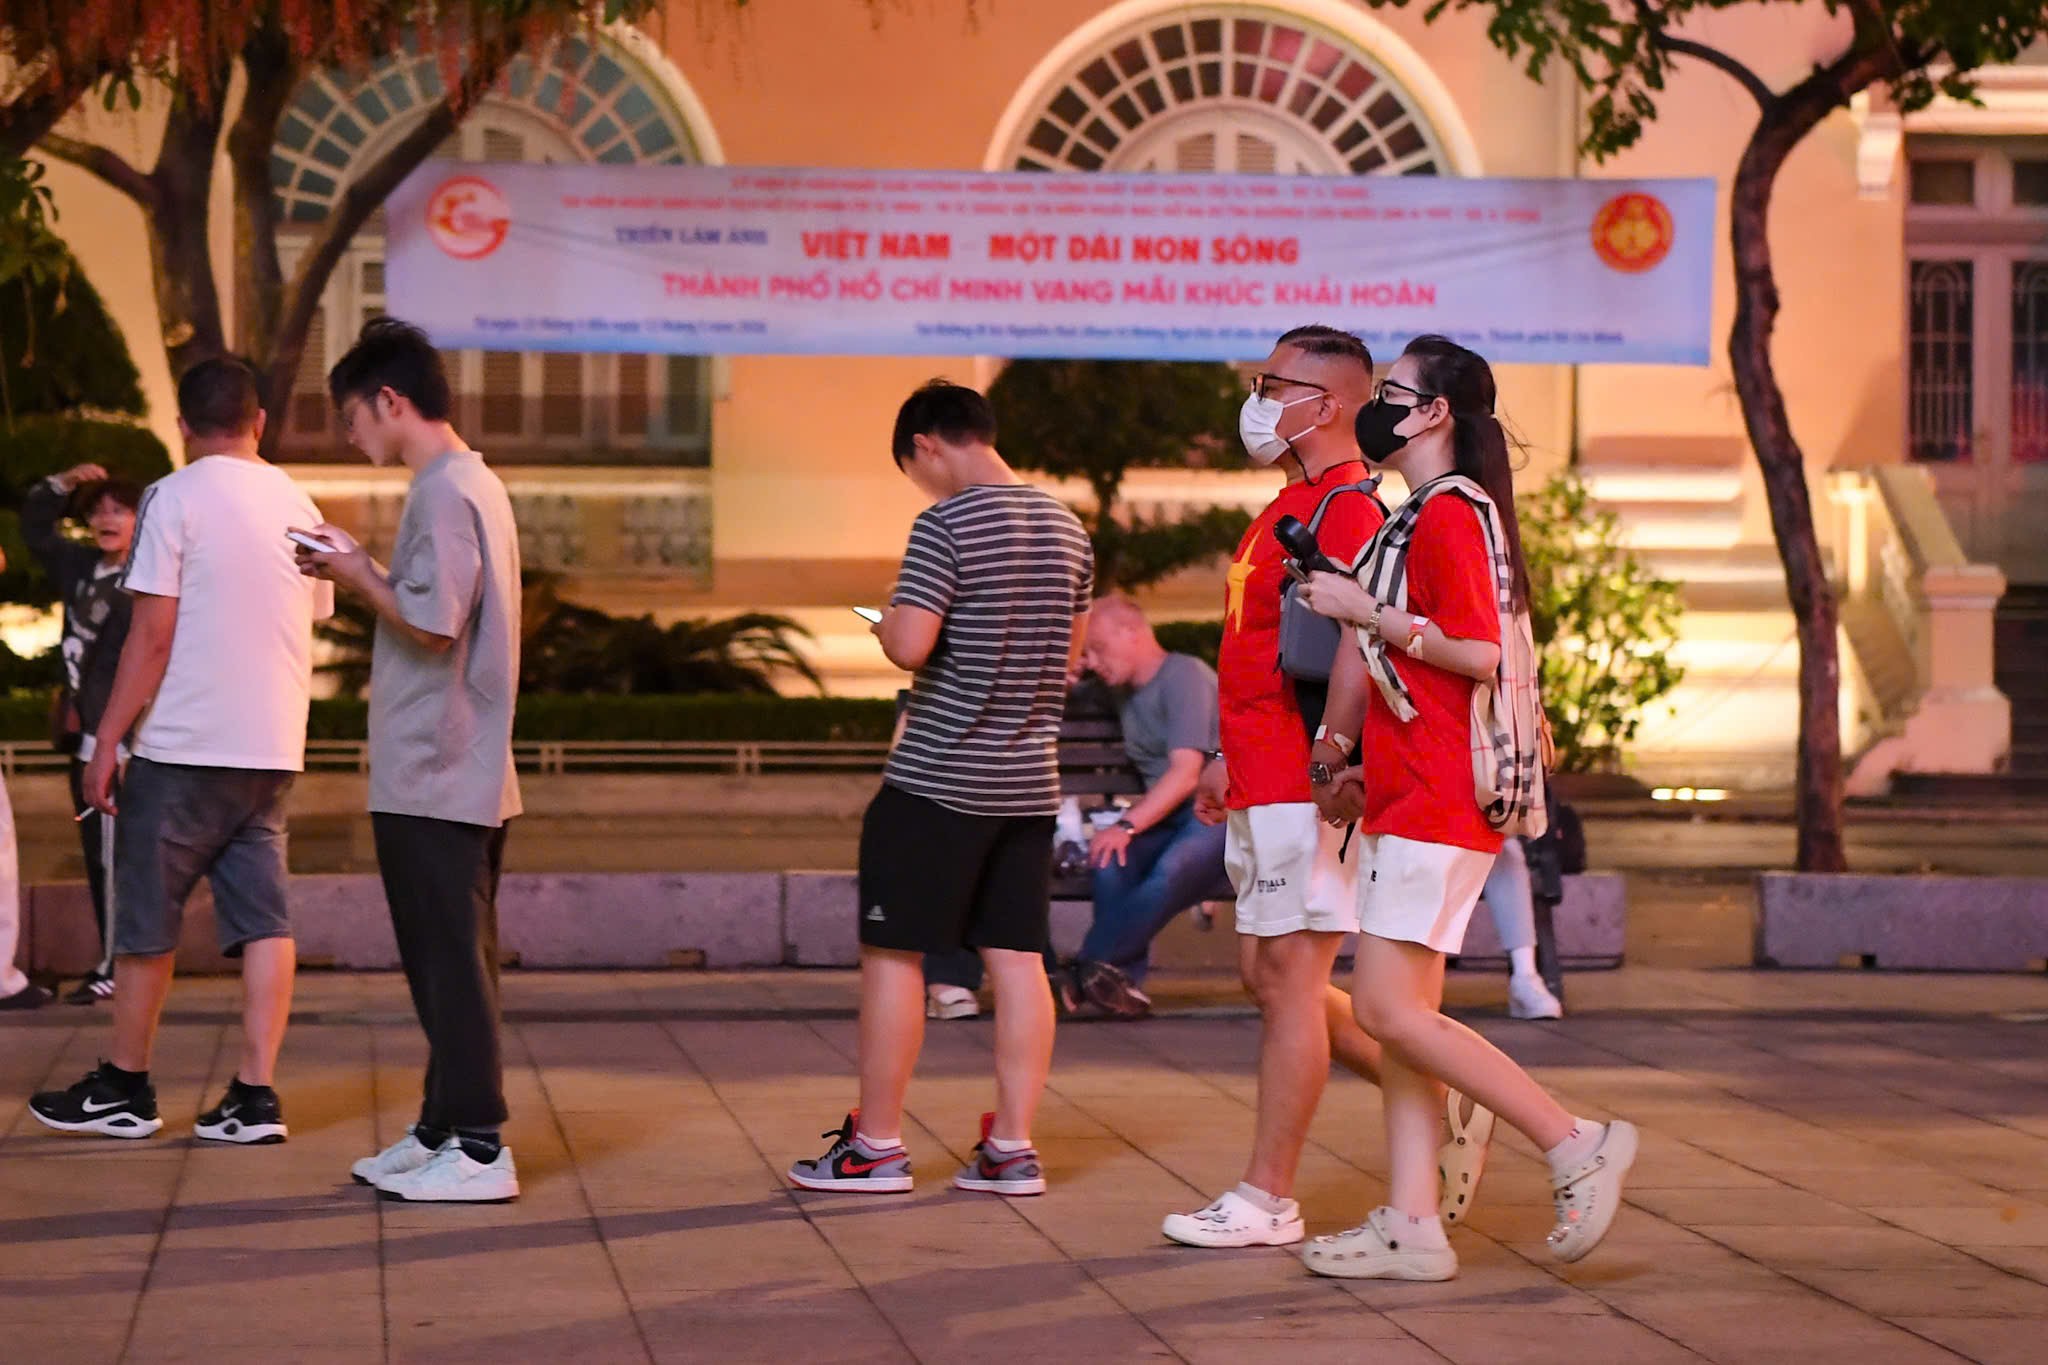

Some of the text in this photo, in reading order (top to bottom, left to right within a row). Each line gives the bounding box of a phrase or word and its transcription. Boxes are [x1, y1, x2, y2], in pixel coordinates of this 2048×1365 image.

[802, 229, 868, 260] VIỆT
[879, 233, 951, 260] NAM
[988, 229, 1058, 263] MỘT
[1131, 236, 1200, 263] NON
[1210, 233, 1299, 265] SÔNG
[768, 270, 831, 300] PHỐ
[890, 273, 942, 301] CHÍ
[950, 278, 1023, 300] MINH
[1031, 280, 1114, 303] VANG
[1184, 279, 1268, 306] KHÚC
